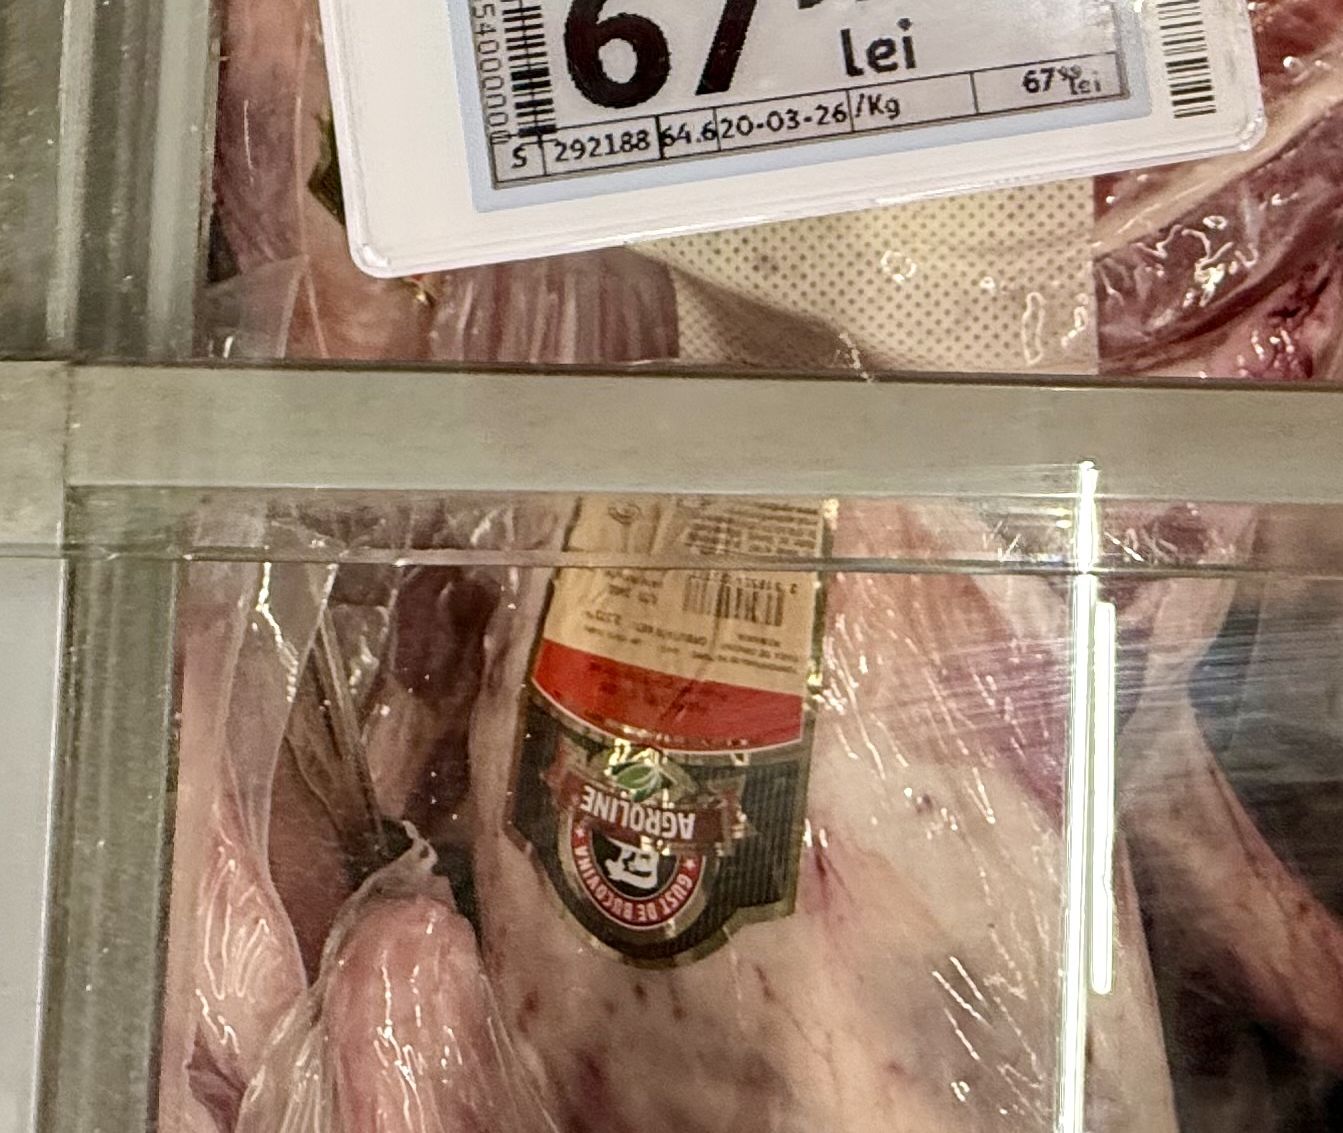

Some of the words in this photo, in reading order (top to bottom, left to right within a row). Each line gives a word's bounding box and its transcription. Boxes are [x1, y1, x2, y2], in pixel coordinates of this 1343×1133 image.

[839, 17, 918, 78] lei
[1021, 66, 1056, 94] 67
[554, 129, 651, 163] 292188
[720, 102, 849, 141] 20-03-26
[854, 93, 902, 121] /Kg
[579, 784, 696, 840] AGROLINE
[573, 844, 635, 921] BUCOVINA
[657, 872, 694, 916] GUST
[637, 902, 659, 922] DE
